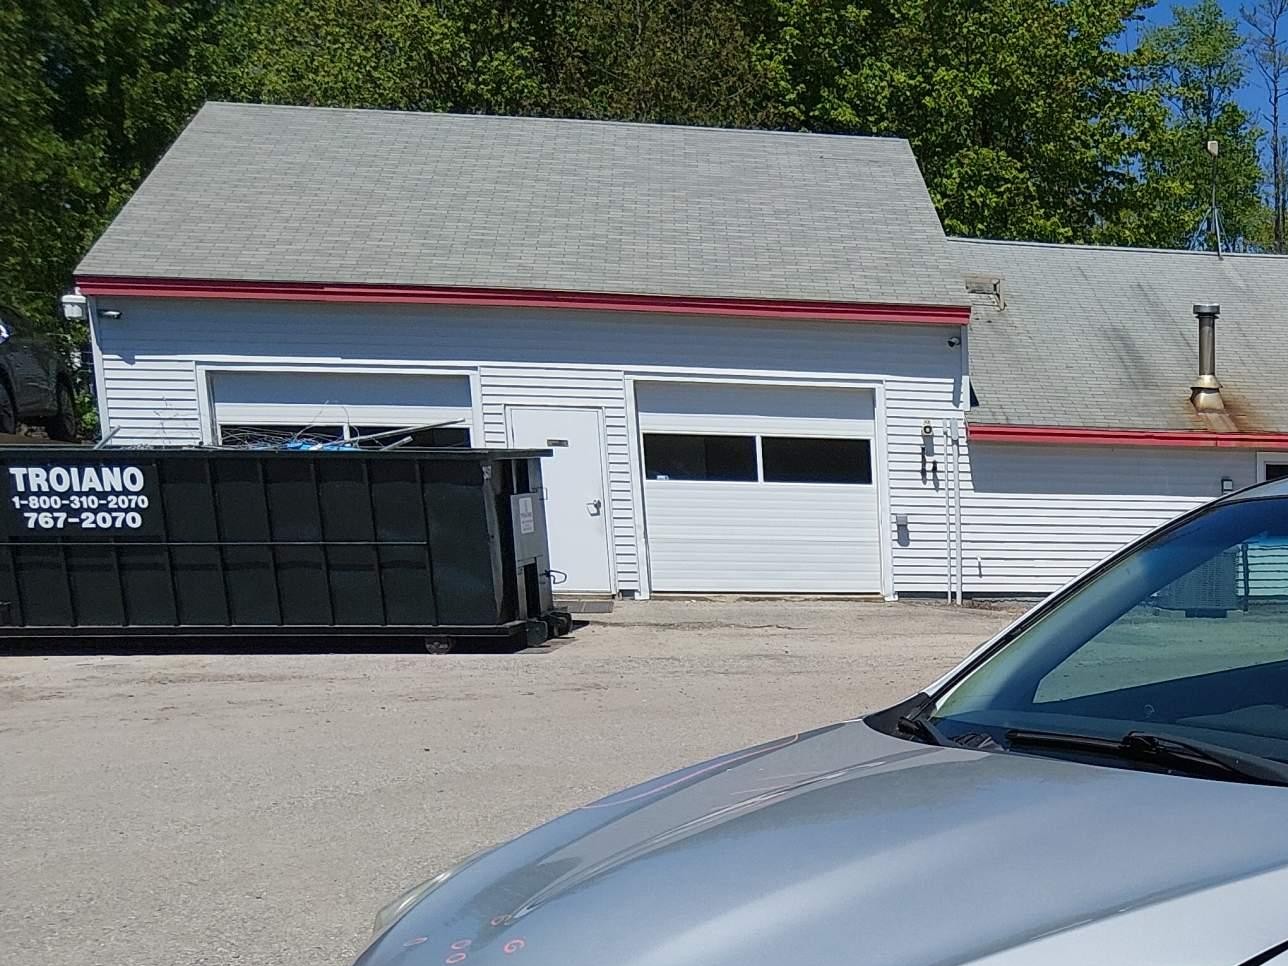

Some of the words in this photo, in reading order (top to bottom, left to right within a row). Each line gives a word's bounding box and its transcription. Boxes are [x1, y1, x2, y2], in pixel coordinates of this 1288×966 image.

[8, 466, 145, 493] TROIANO
[11, 495, 149, 509] 1-800-310-2070
[23, 511, 143, 529] 767-2070
